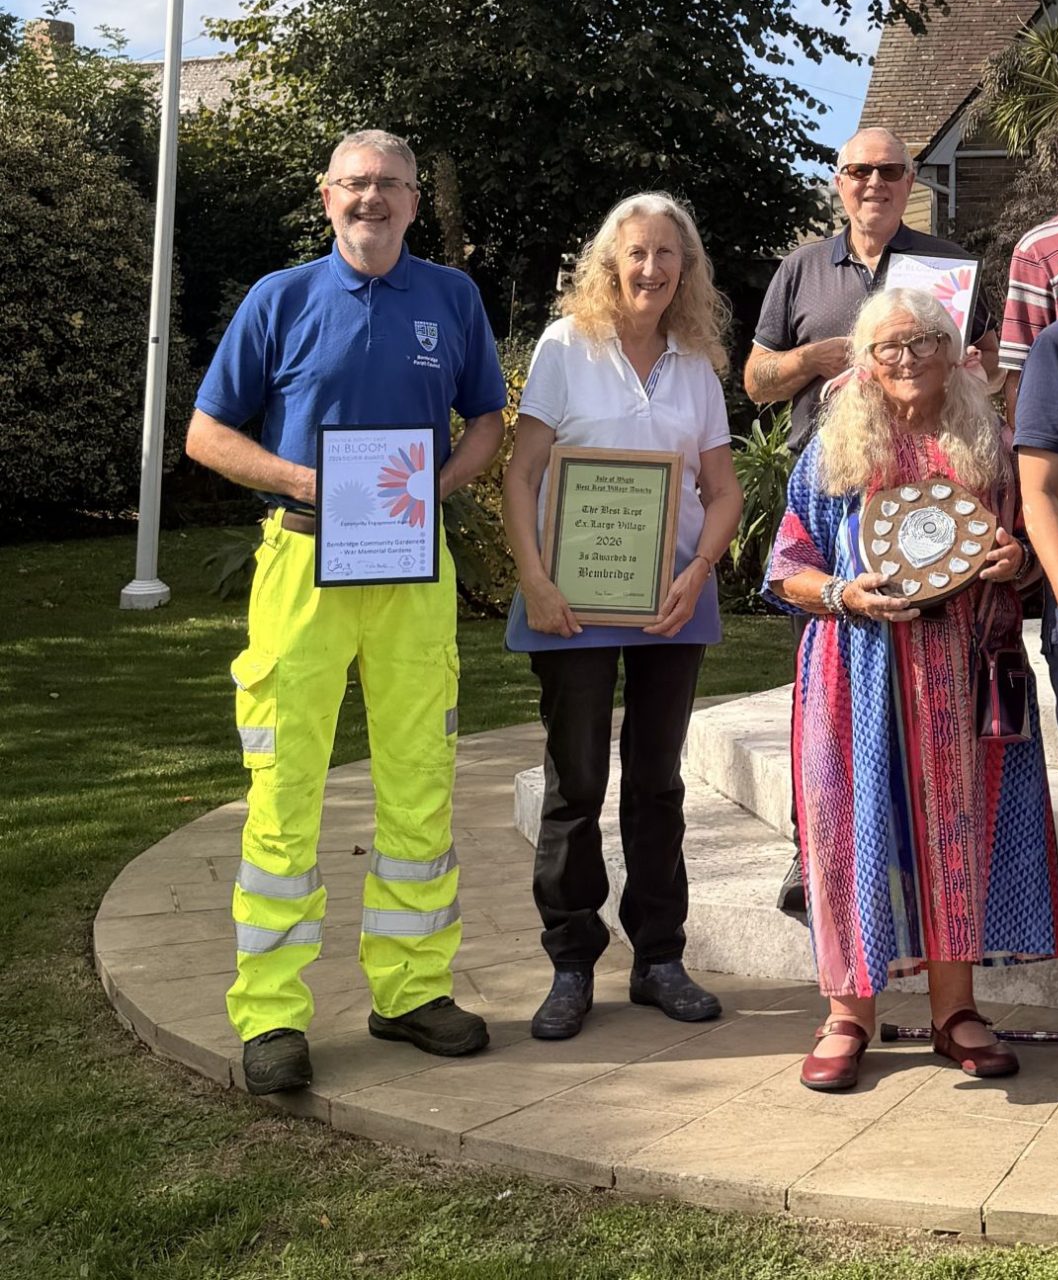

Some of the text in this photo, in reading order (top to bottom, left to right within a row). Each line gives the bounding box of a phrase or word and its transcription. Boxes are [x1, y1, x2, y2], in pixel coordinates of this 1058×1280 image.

[328, 442, 387, 454] IN BLOOM
[581, 505, 642, 516] The Best Kept
[590, 519, 615, 530] Large
[617, 521, 646, 531] Village
[360, 540, 393, 548] Community
[358, 547, 386, 555] Memorial
[387, 546, 411, 554] Gardens
[578, 551, 589, 561] Is
[591, 551, 627, 562] Awarded
[577, 566, 635, 581] Bembridge
